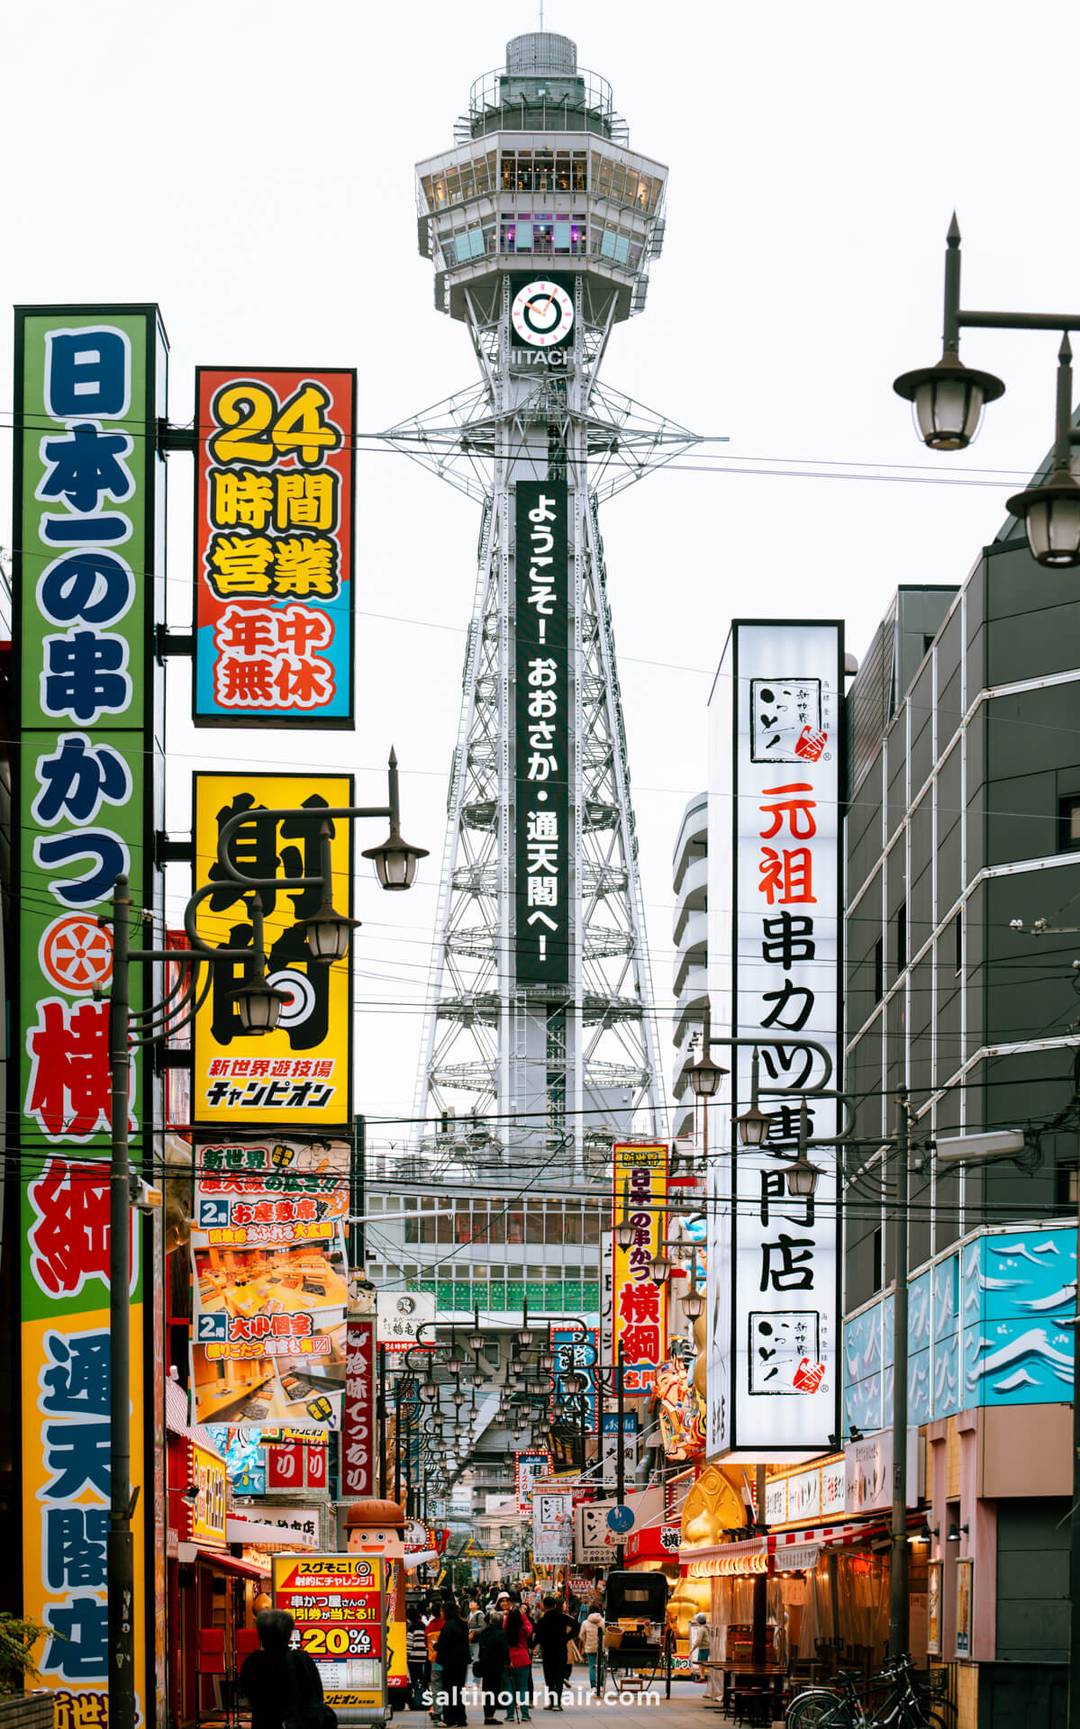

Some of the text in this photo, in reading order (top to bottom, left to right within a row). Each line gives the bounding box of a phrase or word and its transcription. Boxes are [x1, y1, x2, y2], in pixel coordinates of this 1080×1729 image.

[502, 350, 583, 366] HITACHI
[208, 380, 342, 468] 24
[208, 468, 341, 532] 時間
[205, 533, 341, 601] 営業
[218, 609, 331, 656] 年中
[218, 657, 331, 705] 無休
[208, 1058, 335, 1079] 新世界遊技場
[206, 1081, 334, 1108] チャンピオン
[201, 1148, 267, 1170] 新世界
[605, 1419, 634, 1430] Ashi
[300, 1562, 352, 1574] スグそこ!
[295, 1575, 374, 1587] 射的にチャレンジ!
[291, 1595, 366, 1608] 串かつ屋さんの
[349, 1644, 371, 1654] OFF
